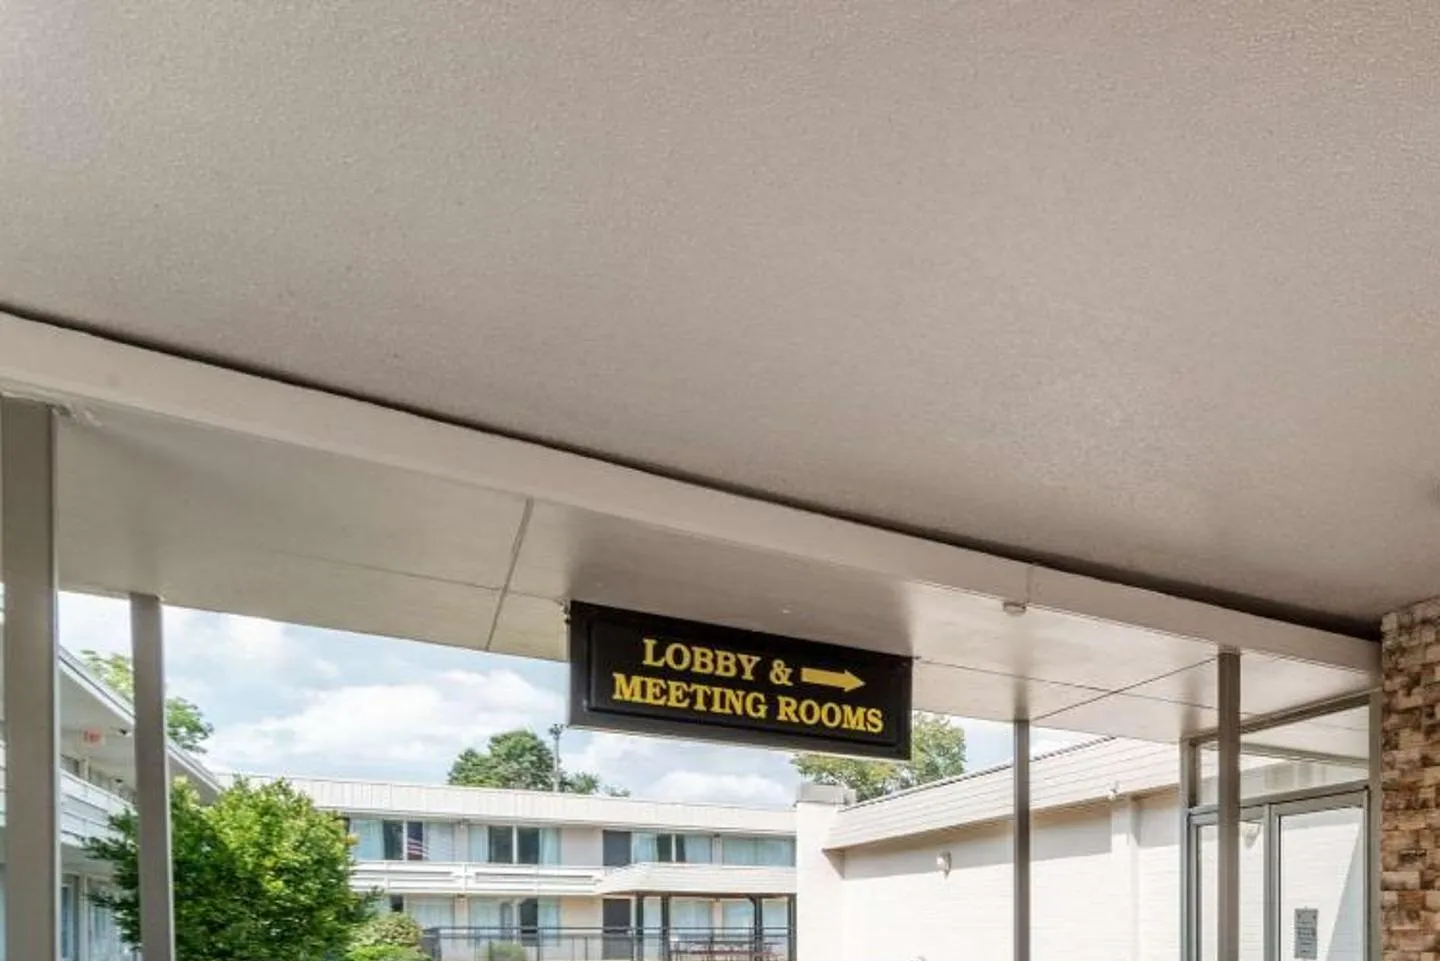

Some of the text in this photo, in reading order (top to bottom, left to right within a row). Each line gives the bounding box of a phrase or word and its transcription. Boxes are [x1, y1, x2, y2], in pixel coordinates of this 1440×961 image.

[643, 638, 794, 686] LOBBY &
[612, 672, 884, 734] MEETING ROOMS
